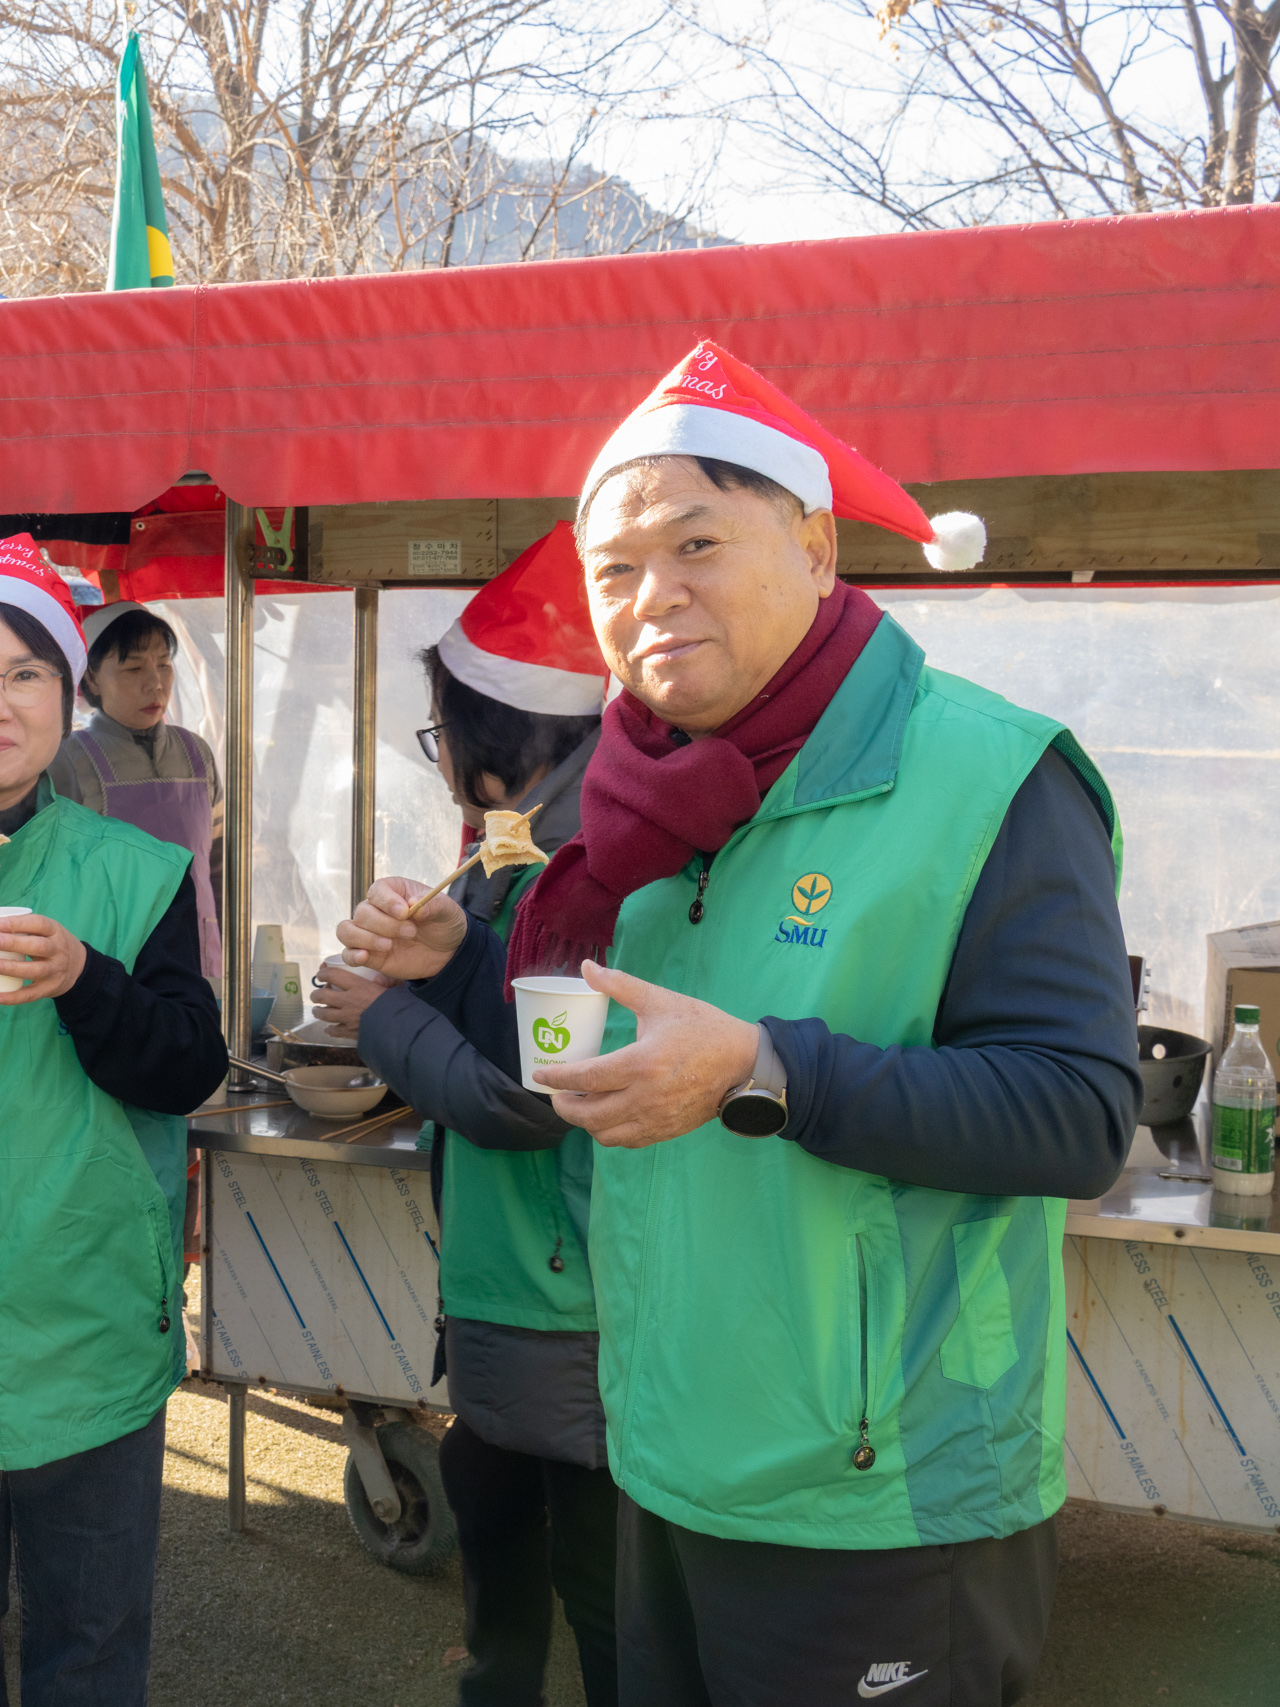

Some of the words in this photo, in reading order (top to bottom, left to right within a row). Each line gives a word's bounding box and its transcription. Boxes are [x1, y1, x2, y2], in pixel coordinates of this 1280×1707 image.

[774, 921, 828, 948] SMU
[214, 1150, 233, 1178] NLESS
[228, 1181, 247, 1209] STEEL
[300, 1158, 320, 1187] NLESS
[315, 1190, 335, 1219] STEEL
[389, 1167, 410, 1197] NLESS
[405, 1199, 425, 1227] STEEL
[1124, 1240, 1151, 1275] NLESS
[1147, 1278, 1169, 1313] STEEL
[1245, 1252, 1273, 1288] NLESS
[213, 1319, 242, 1368] STAINLESS
[302, 1330, 333, 1380] STAINLESS
[391, 1342, 422, 1393] STAINLESS
[1120, 1442, 1160, 1500] STAINLESS
[1240, 1459, 1280, 1518] STAINLESS
[866, 1661, 911, 1682] NIKE
